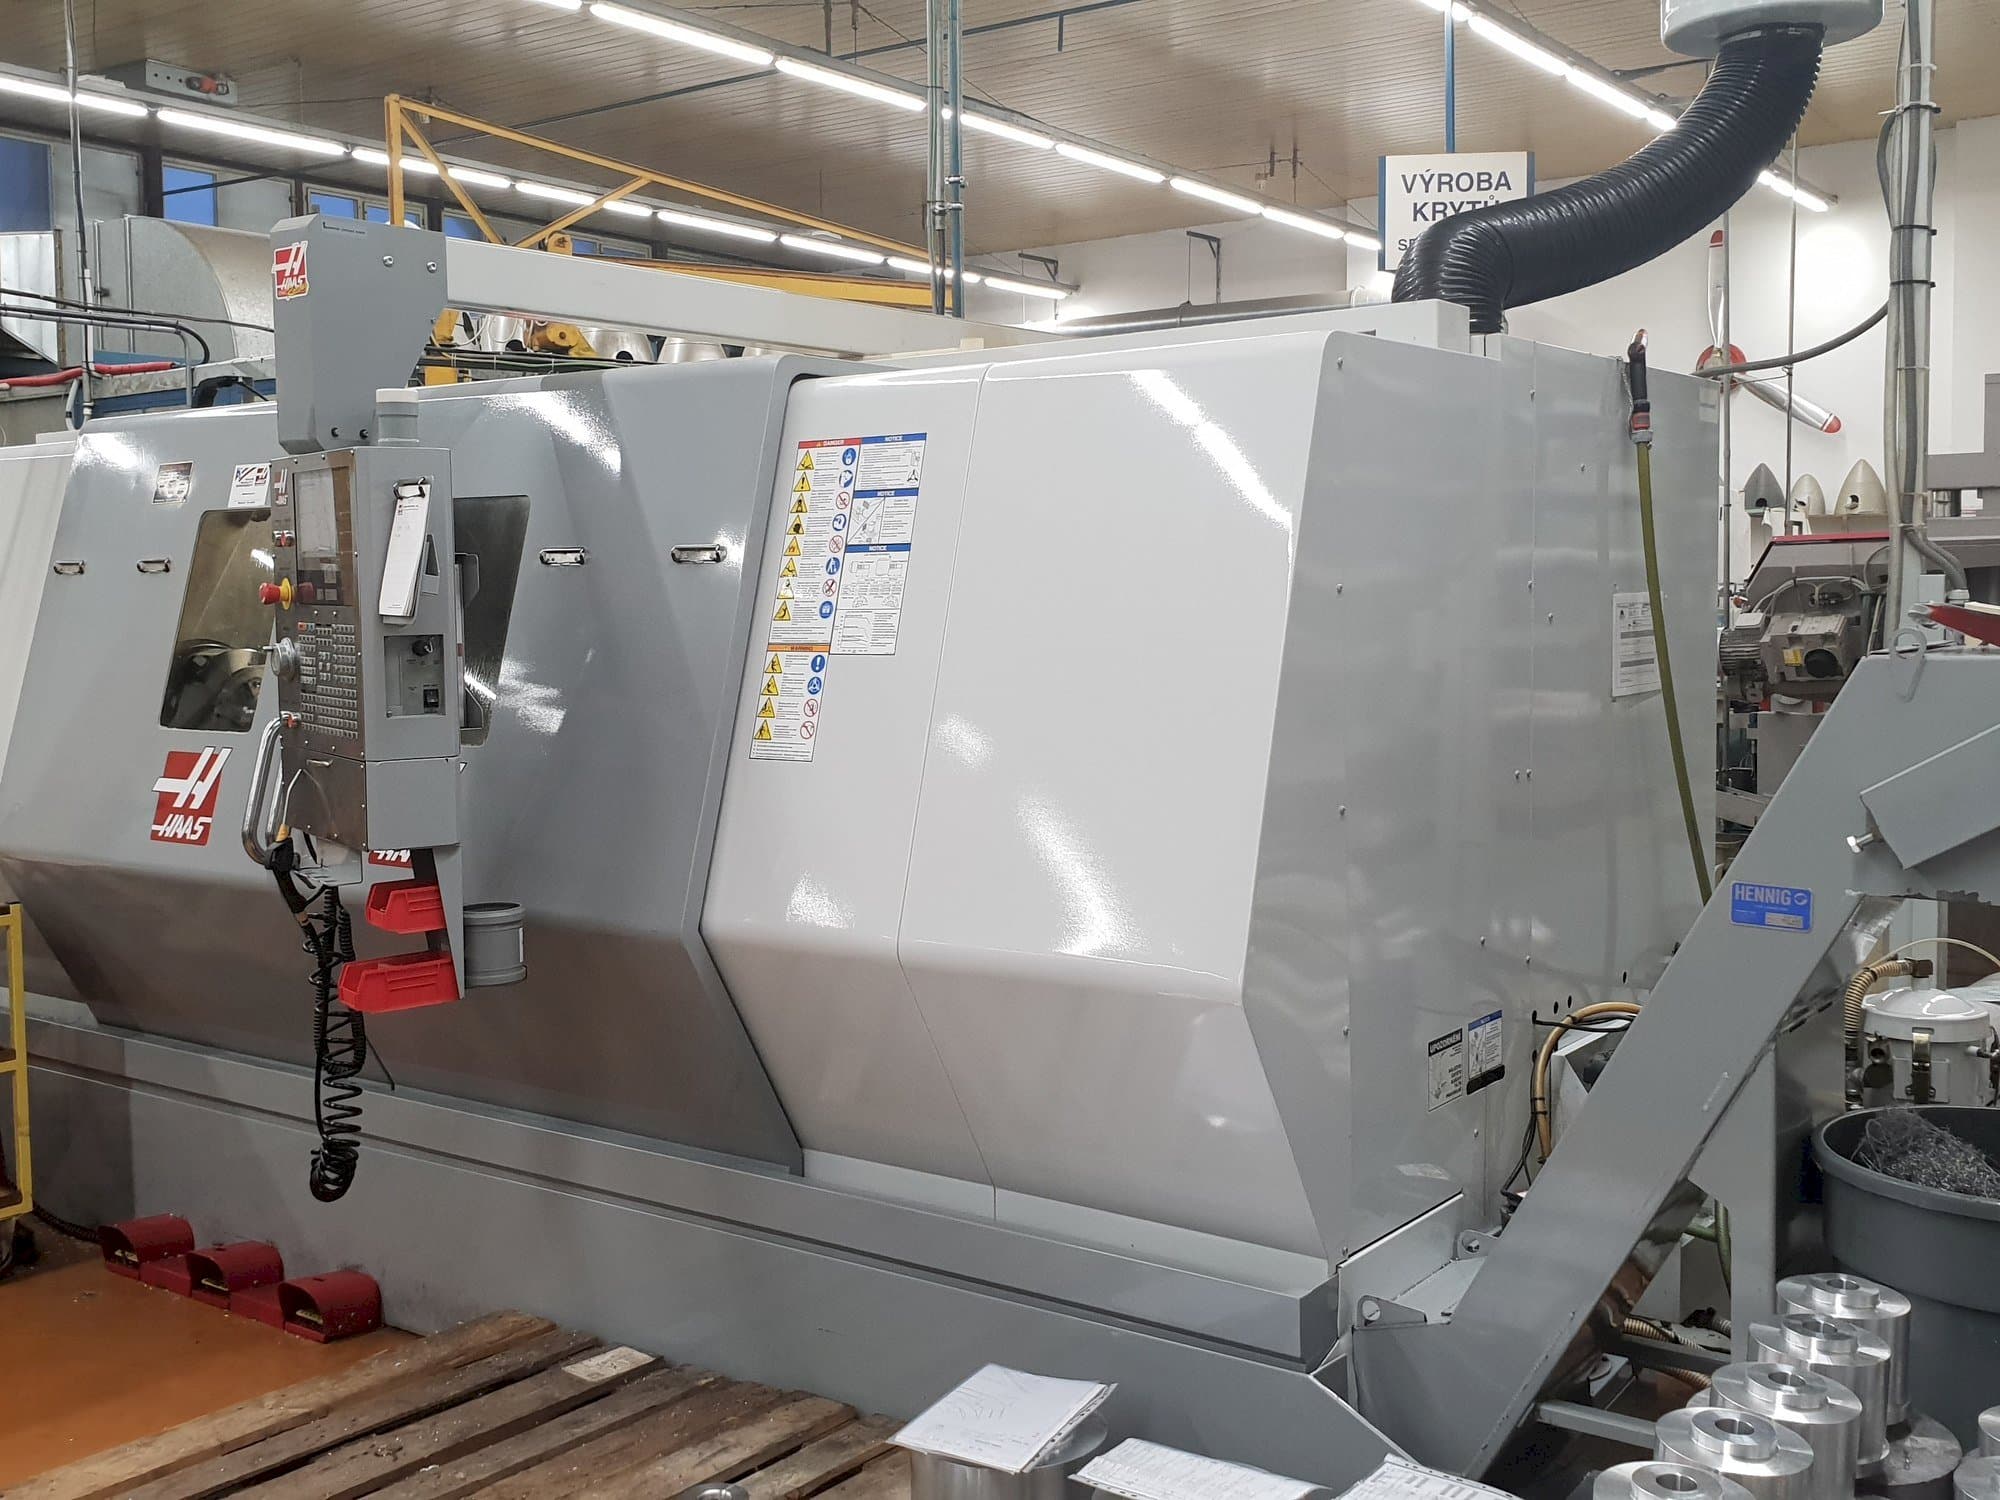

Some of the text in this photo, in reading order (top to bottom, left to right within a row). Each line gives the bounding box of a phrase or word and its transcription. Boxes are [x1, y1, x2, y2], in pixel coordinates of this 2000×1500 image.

[1401, 168, 1512, 194] VÝROBA
[151, 813, 213, 840] HAAS
[1734, 883, 1792, 906] HENNIG
